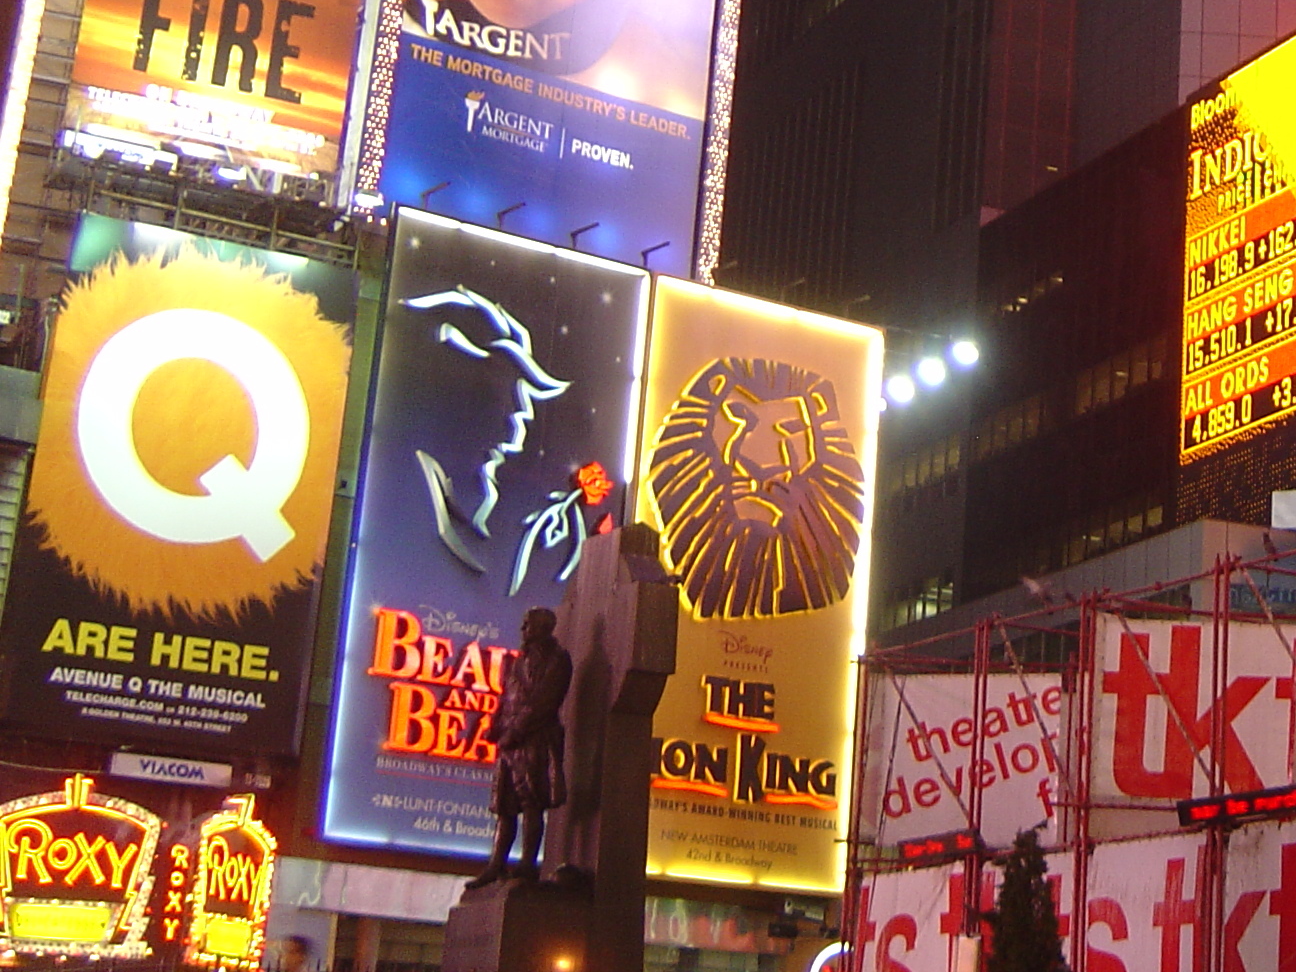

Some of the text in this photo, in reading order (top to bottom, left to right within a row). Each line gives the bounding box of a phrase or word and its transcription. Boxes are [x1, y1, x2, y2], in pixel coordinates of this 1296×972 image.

[436, 9, 571, 60] ARGENT
[410, 43, 692, 140] THE MORTGAGE INDUSTRY'S LEADER.
[477, 101, 554, 139] ARGENT
[482, 126, 547, 153] MORTGAGE
[571, 138, 634, 170] PROVEN.
[1189, 215, 1246, 265] NIKKEI
[1187, 268, 1295, 340] HANG SENG
[1185, 356, 1270, 416] ALL ORDS
[77, 307, 310, 563] Q
[41, 618, 279, 682] ARE HERE.
[50, 667, 266, 708] AVENUE Q THE MUSICAL
[65, 690, 164, 713] TELECHARGE.COM
[444, 688, 499, 715] AND
[701, 674, 776, 721] THE
[907, 685, 1062, 764] theatre
[139, 759, 205, 780] VIACOM
[733, 733, 837, 805] KING
[414, 816, 440, 832] 46th
[661, 831, 798, 855] NEW AMSTERDAM THEATRE
[774, 813, 796, 827] BEST
[8, 818, 137, 889] ROXY
[686, 847, 713, 863] 42nd
[725, 852, 773, 871] Broadway
[165, 844, 189, 940] ROXY
